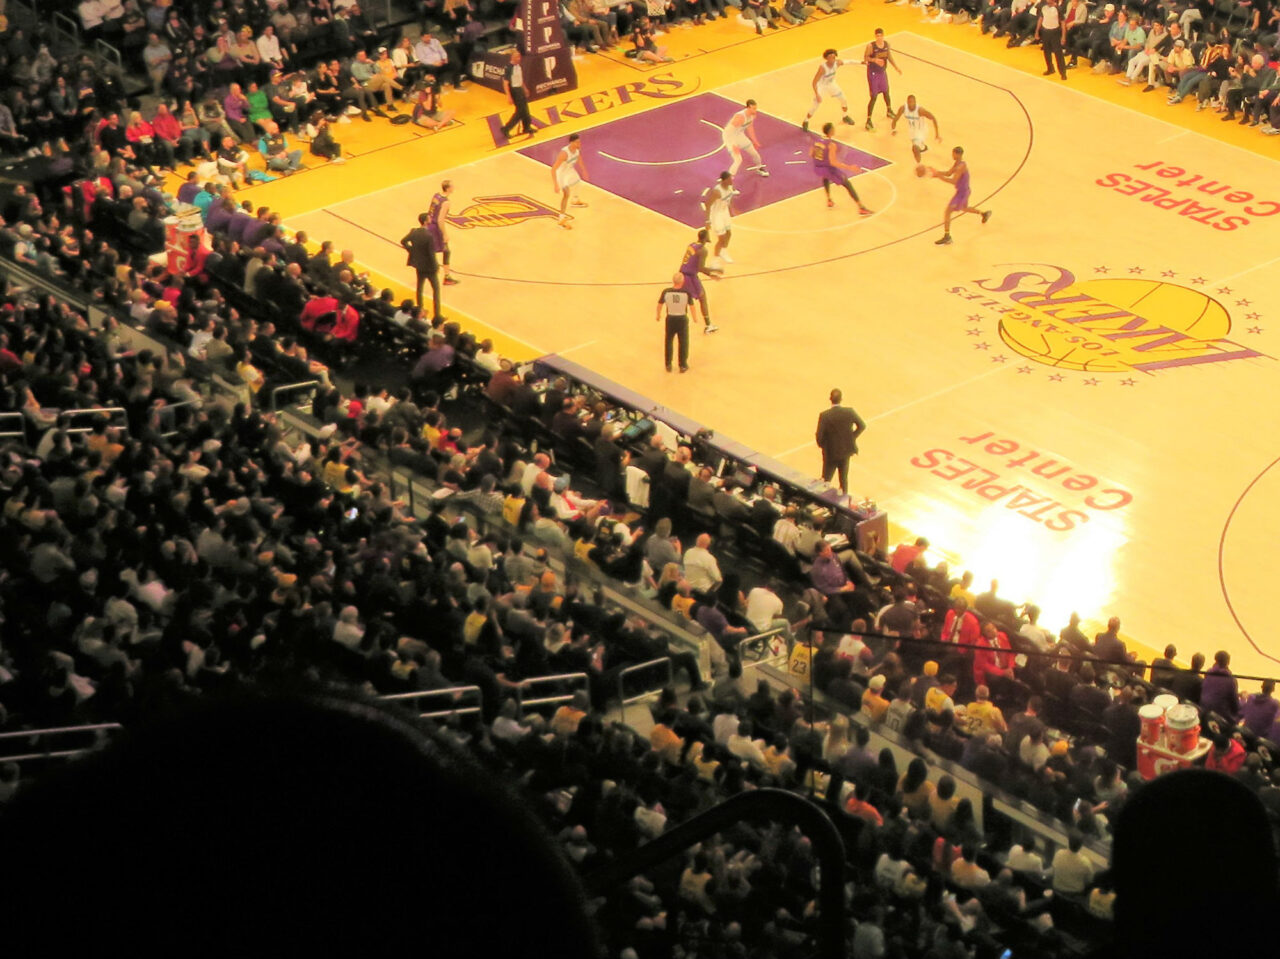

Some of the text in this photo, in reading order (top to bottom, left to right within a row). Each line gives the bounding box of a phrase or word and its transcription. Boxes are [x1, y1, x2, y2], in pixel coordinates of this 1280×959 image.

[1095, 172, 1250, 232] STAPLES
[972, 263, 1279, 376] LAKERS
[910, 448, 1090, 532] STAPLES
[958, 432, 1133, 510] Center
